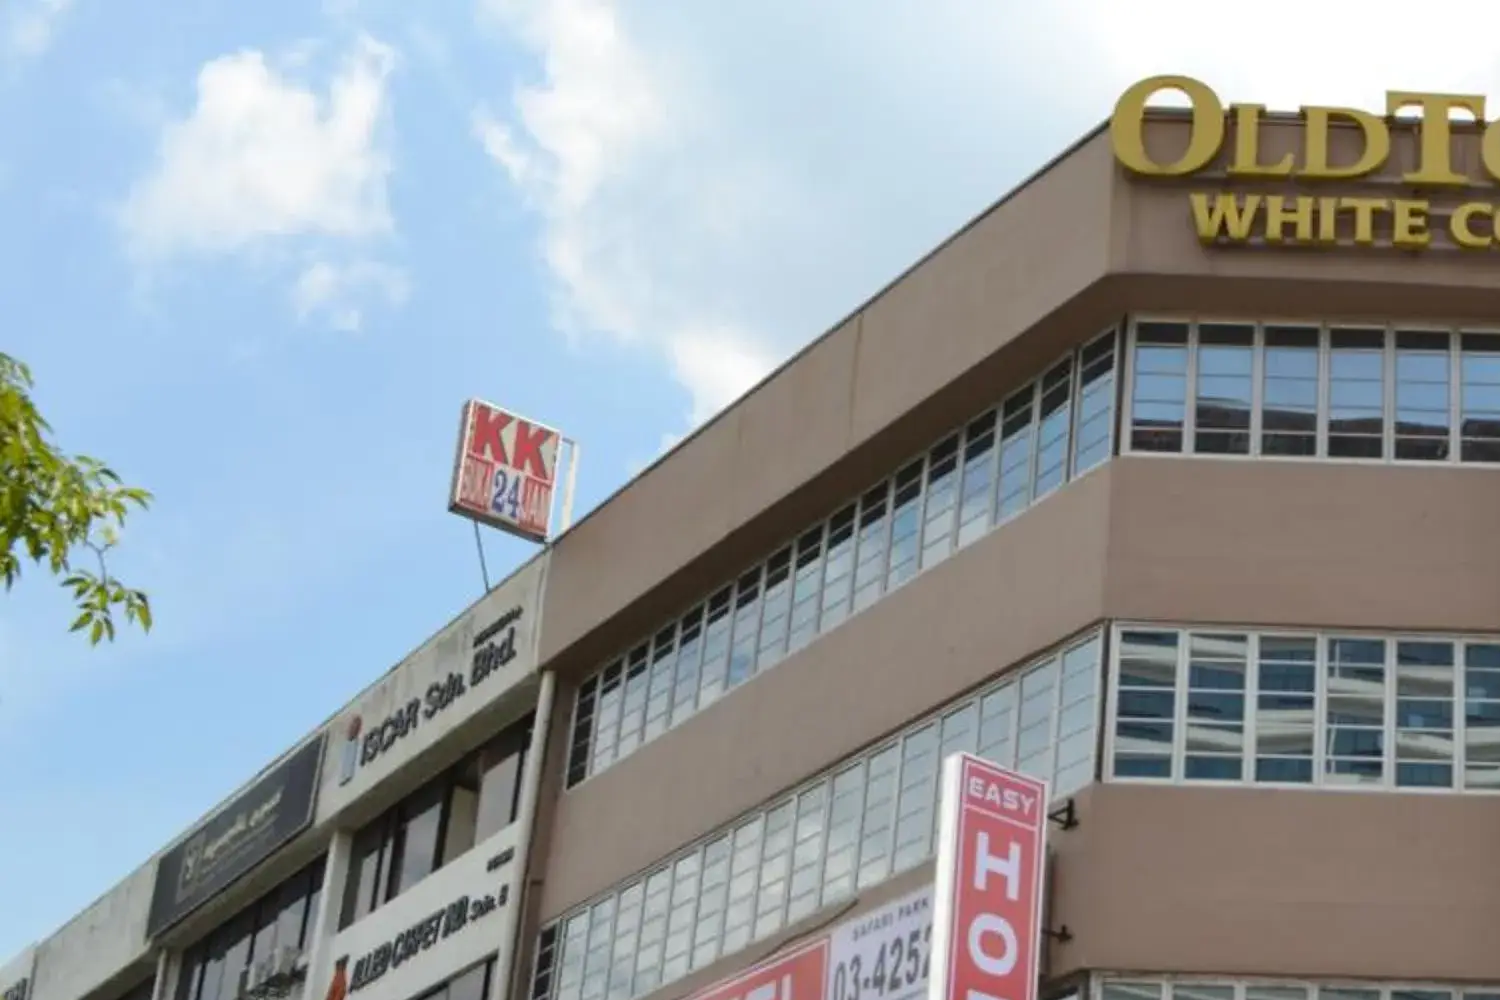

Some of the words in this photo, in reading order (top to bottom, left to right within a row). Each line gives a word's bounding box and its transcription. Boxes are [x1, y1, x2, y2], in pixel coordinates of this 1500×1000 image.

[1190, 192, 1433, 248] WHITE
[473, 404, 553, 480] KK
[491, 469, 521, 519] 24
[969, 775, 1035, 817] EASY
